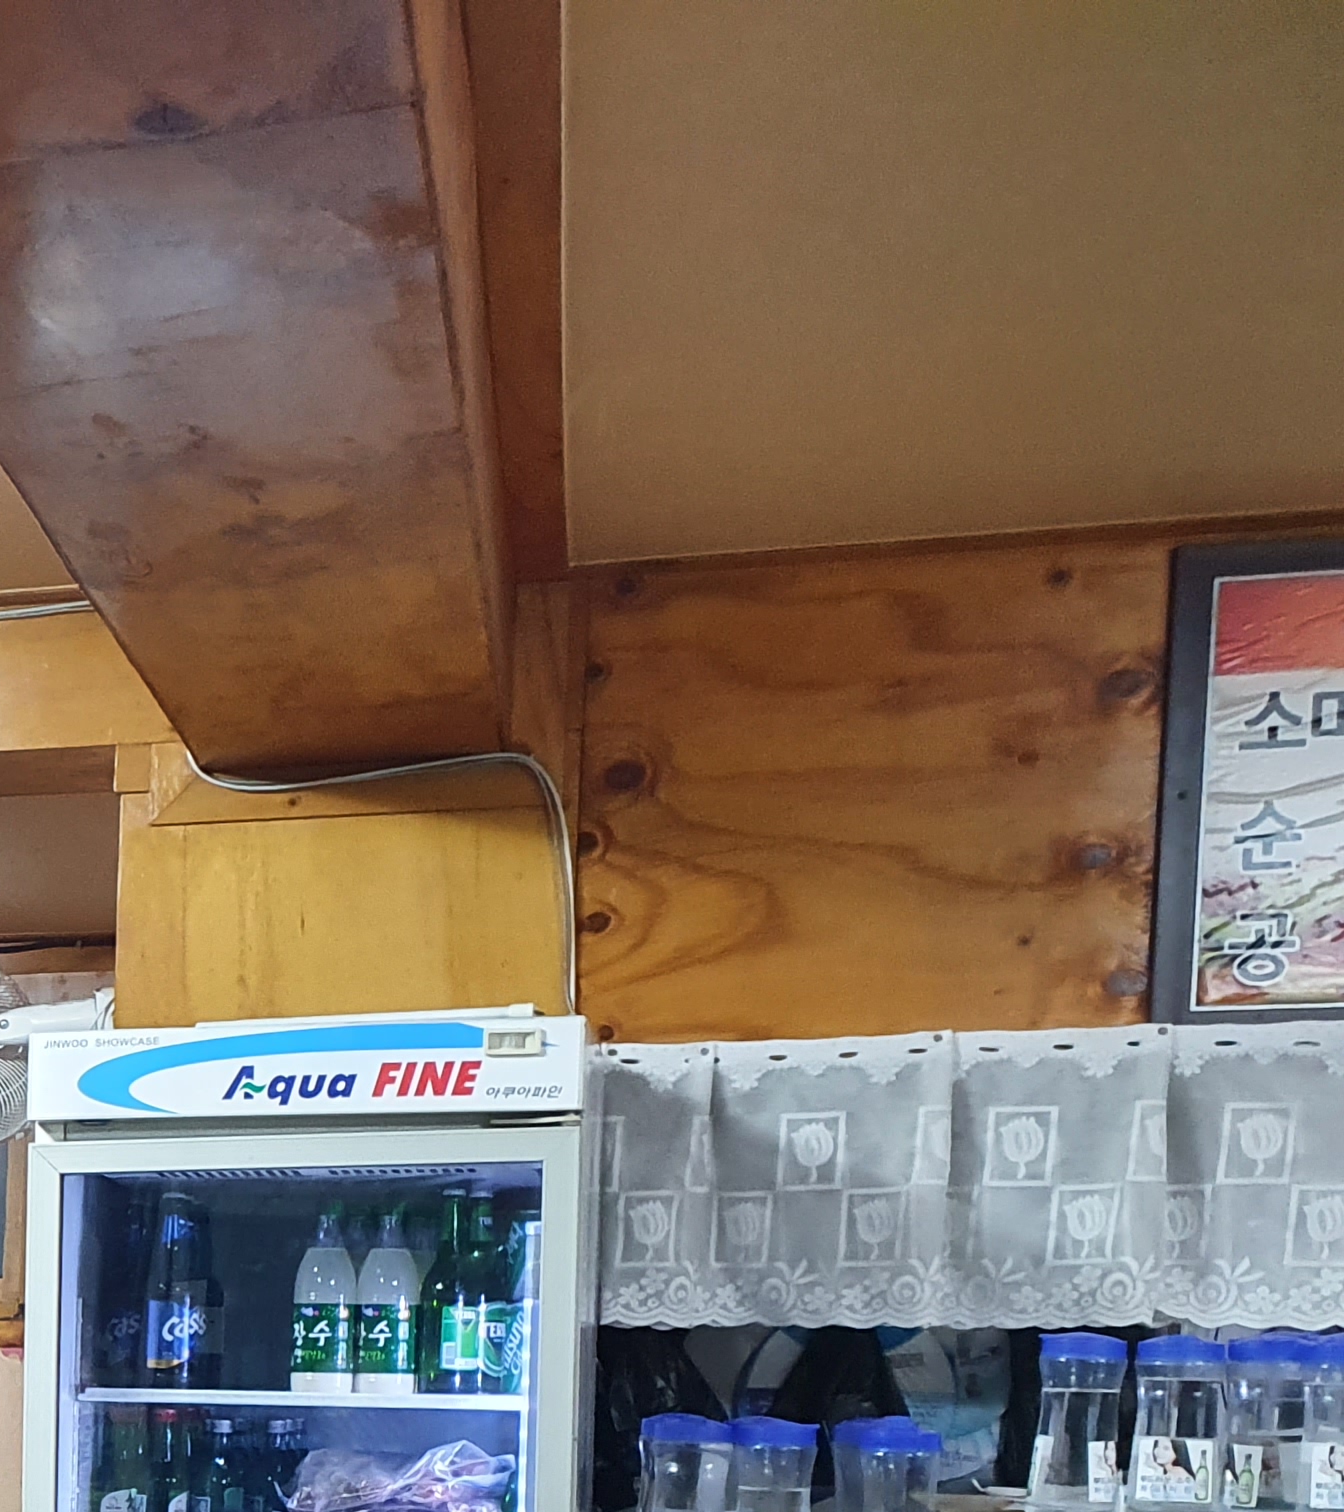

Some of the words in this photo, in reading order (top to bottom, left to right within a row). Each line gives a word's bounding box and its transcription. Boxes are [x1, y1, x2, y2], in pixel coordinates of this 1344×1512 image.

[1233, 799, 1303, 872] 순
[44, 1038, 88, 1049] JINWOO
[95, 1036, 160, 1048] SHOWCASE
[222, 1065, 358, 1106] Aqua
[371, 1060, 483, 1098] FINE
[485, 1085, 564, 1100] 아쿠아파인
